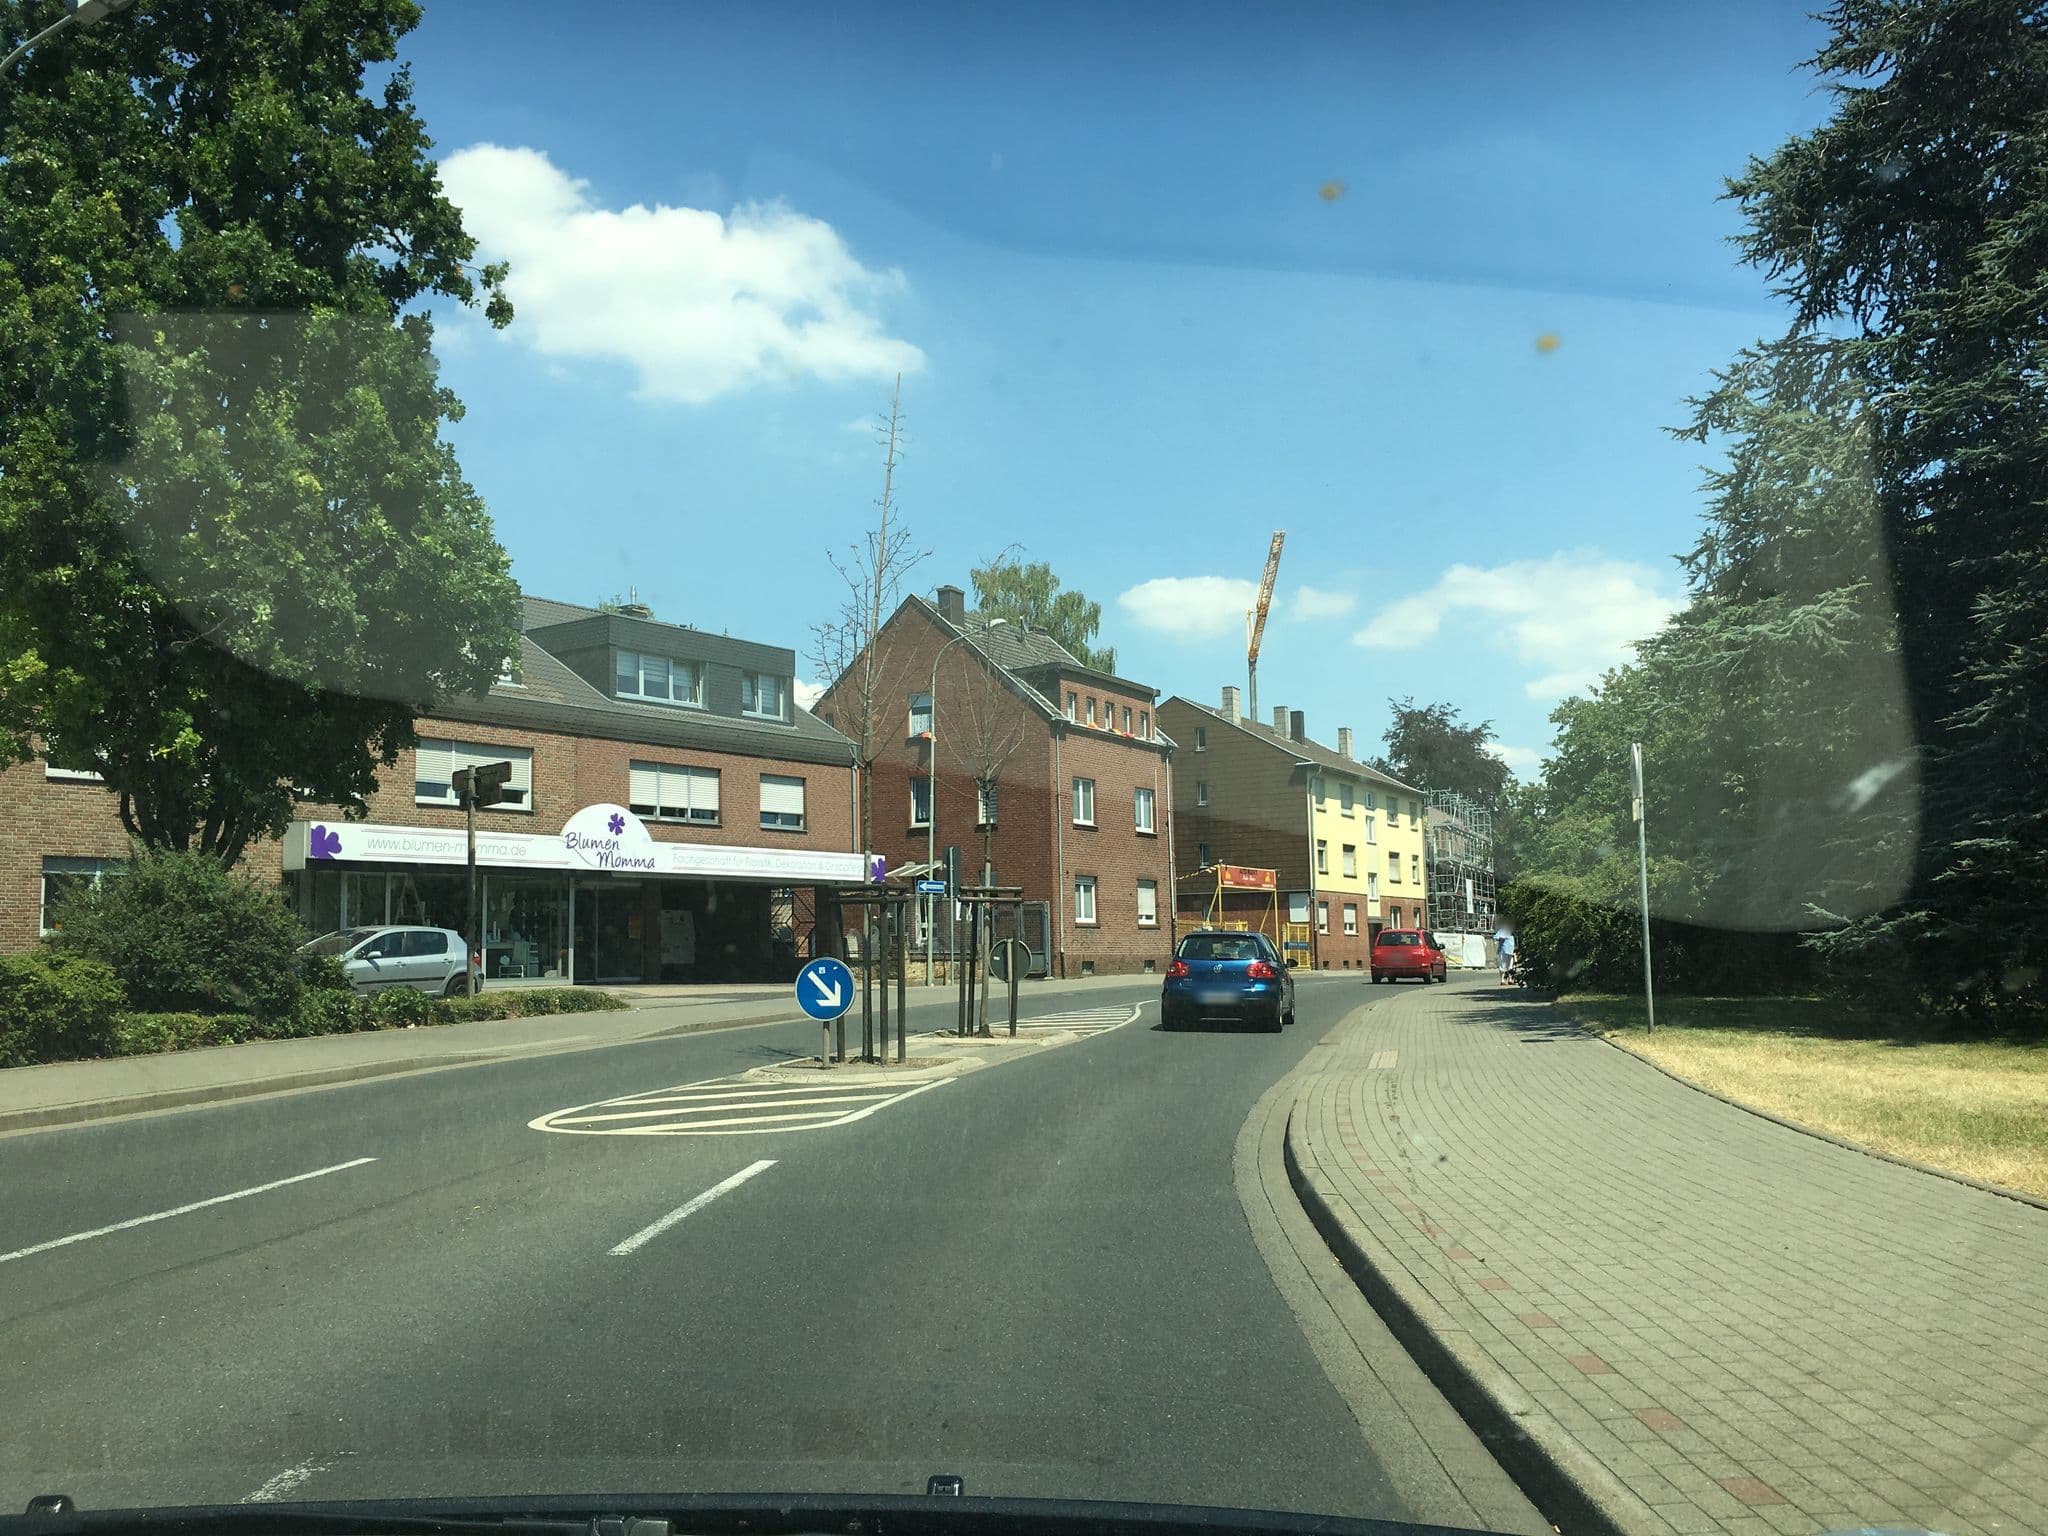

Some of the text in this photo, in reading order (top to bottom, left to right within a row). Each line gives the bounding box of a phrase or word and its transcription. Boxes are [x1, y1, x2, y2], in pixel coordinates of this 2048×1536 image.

[366, 837, 527, 857] www.blumen-mmma.de
[565, 832, 620, 851] Blumen
[596, 850, 655, 869] Momma
